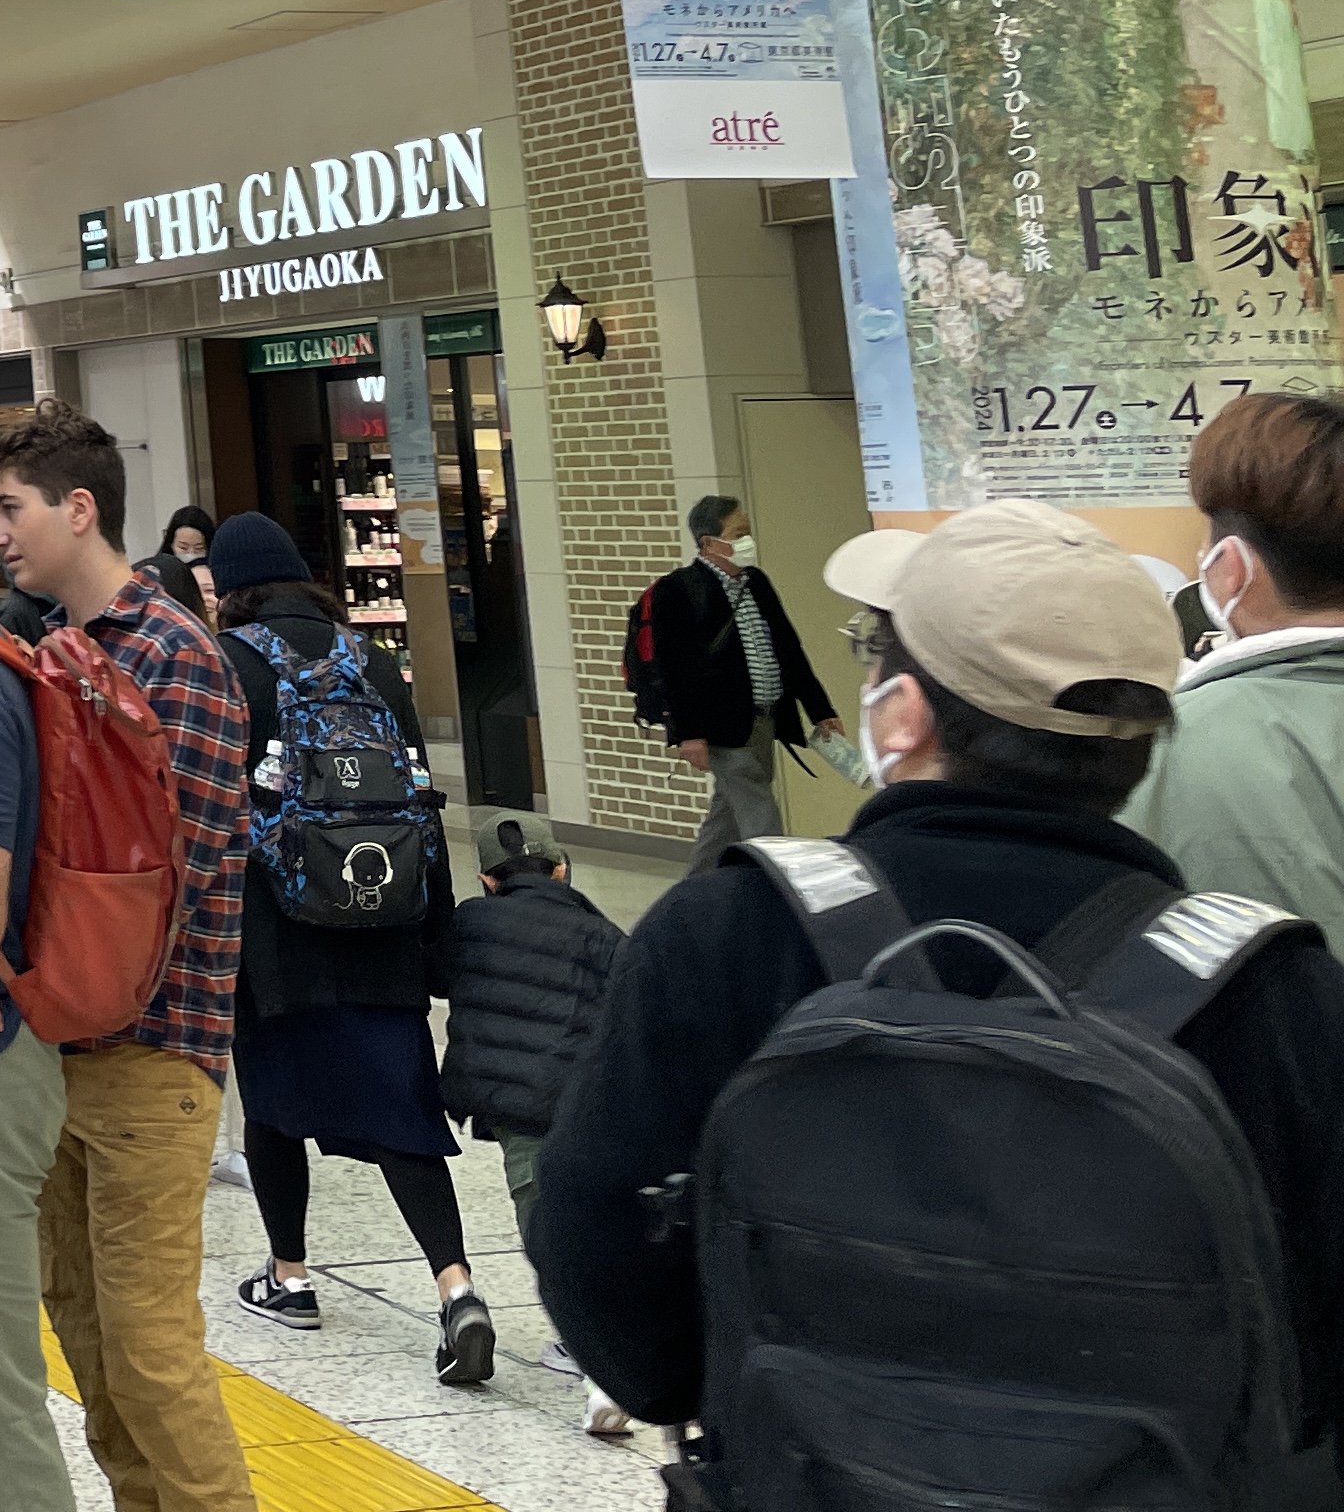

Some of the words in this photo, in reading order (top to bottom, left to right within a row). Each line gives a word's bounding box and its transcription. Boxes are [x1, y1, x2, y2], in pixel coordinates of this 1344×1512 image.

[662, 4, 797, 18] モネからアメリカへ
[711, 110, 782, 143] atré
[124, 181, 229, 265] THE
[238, 126, 488, 247] GARDEN
[218, 246, 385, 303] JIYUGAOKA
[262, 340, 298, 366] THE
[299, 331, 375, 362] GARDEN
[970, 385, 994, 432] 2024
